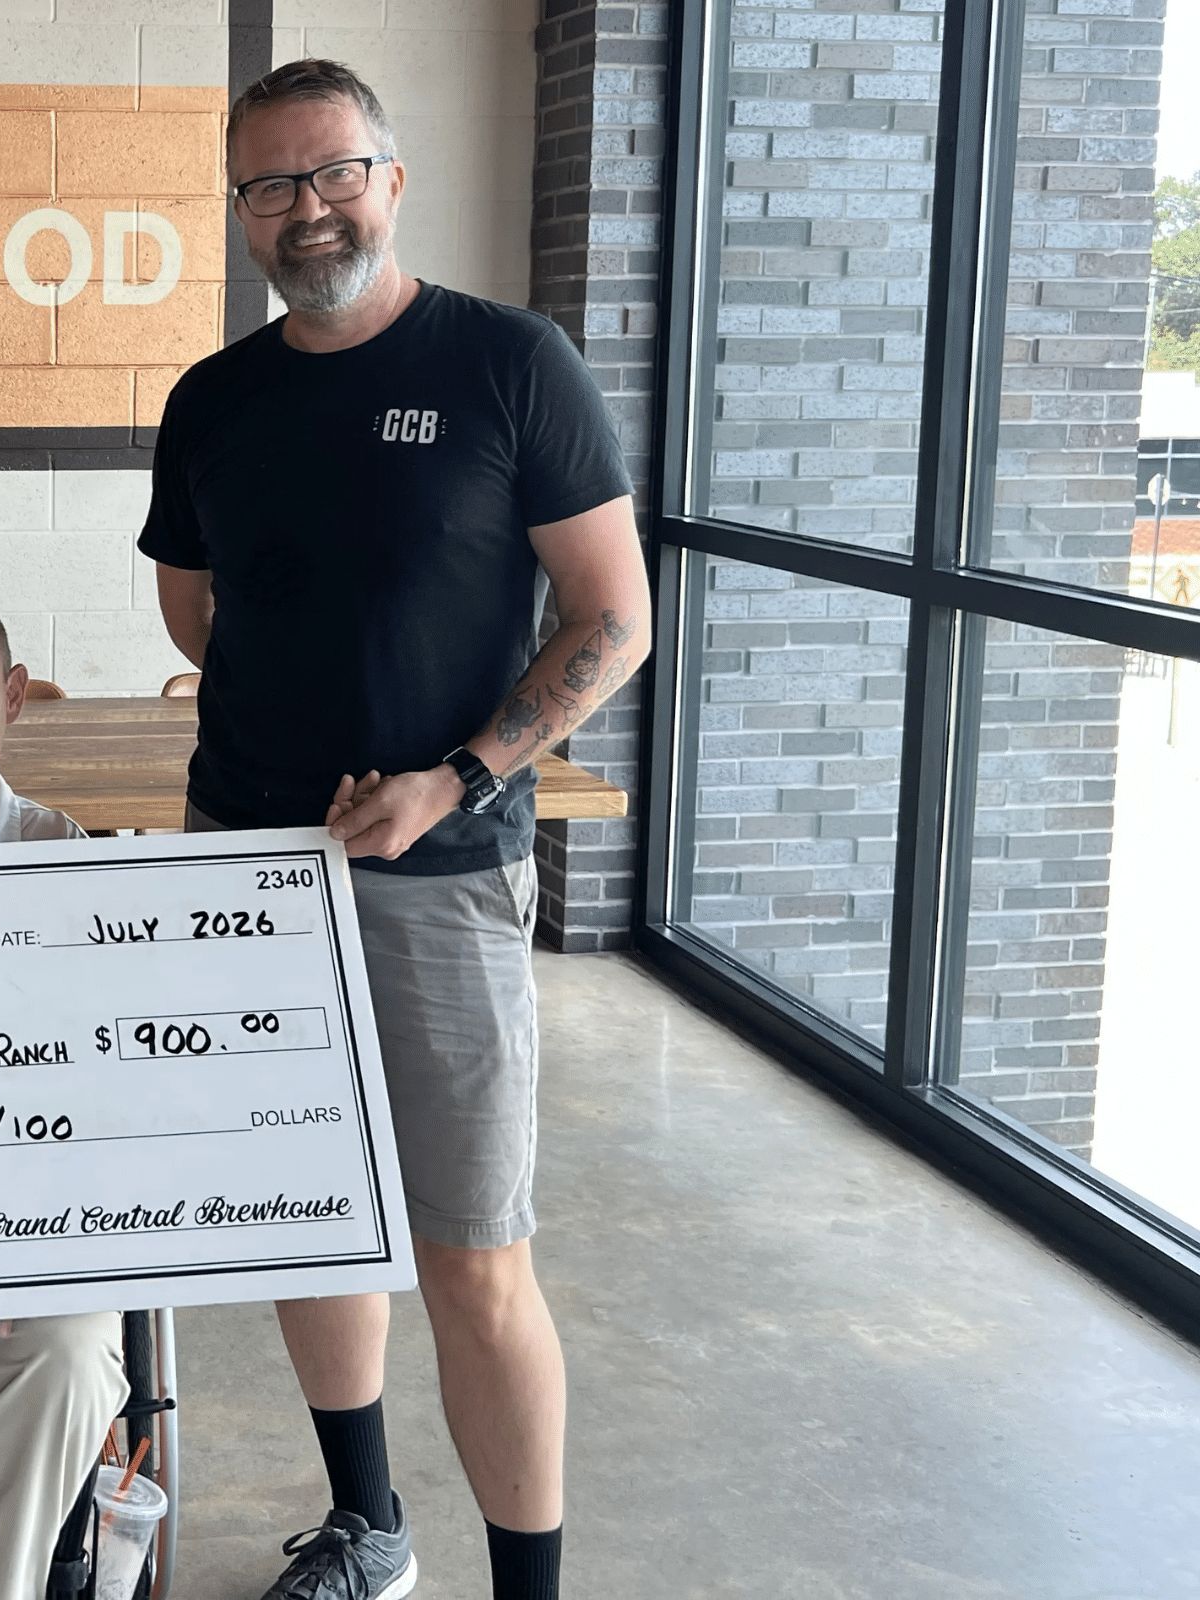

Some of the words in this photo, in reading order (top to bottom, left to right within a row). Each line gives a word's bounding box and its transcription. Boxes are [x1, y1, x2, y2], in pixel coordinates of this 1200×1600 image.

[381, 408, 439, 444] GCB
[256, 869, 314, 890] 2340
[88, 914, 159, 944] JULY
[191, 910, 275, 939] 2026
[96, 1026, 112, 1055] $
[251, 1107, 343, 1128] DOLLARS
[81, 1200, 186, 1234] Central
[195, 1194, 352, 1226] Brewhouse
